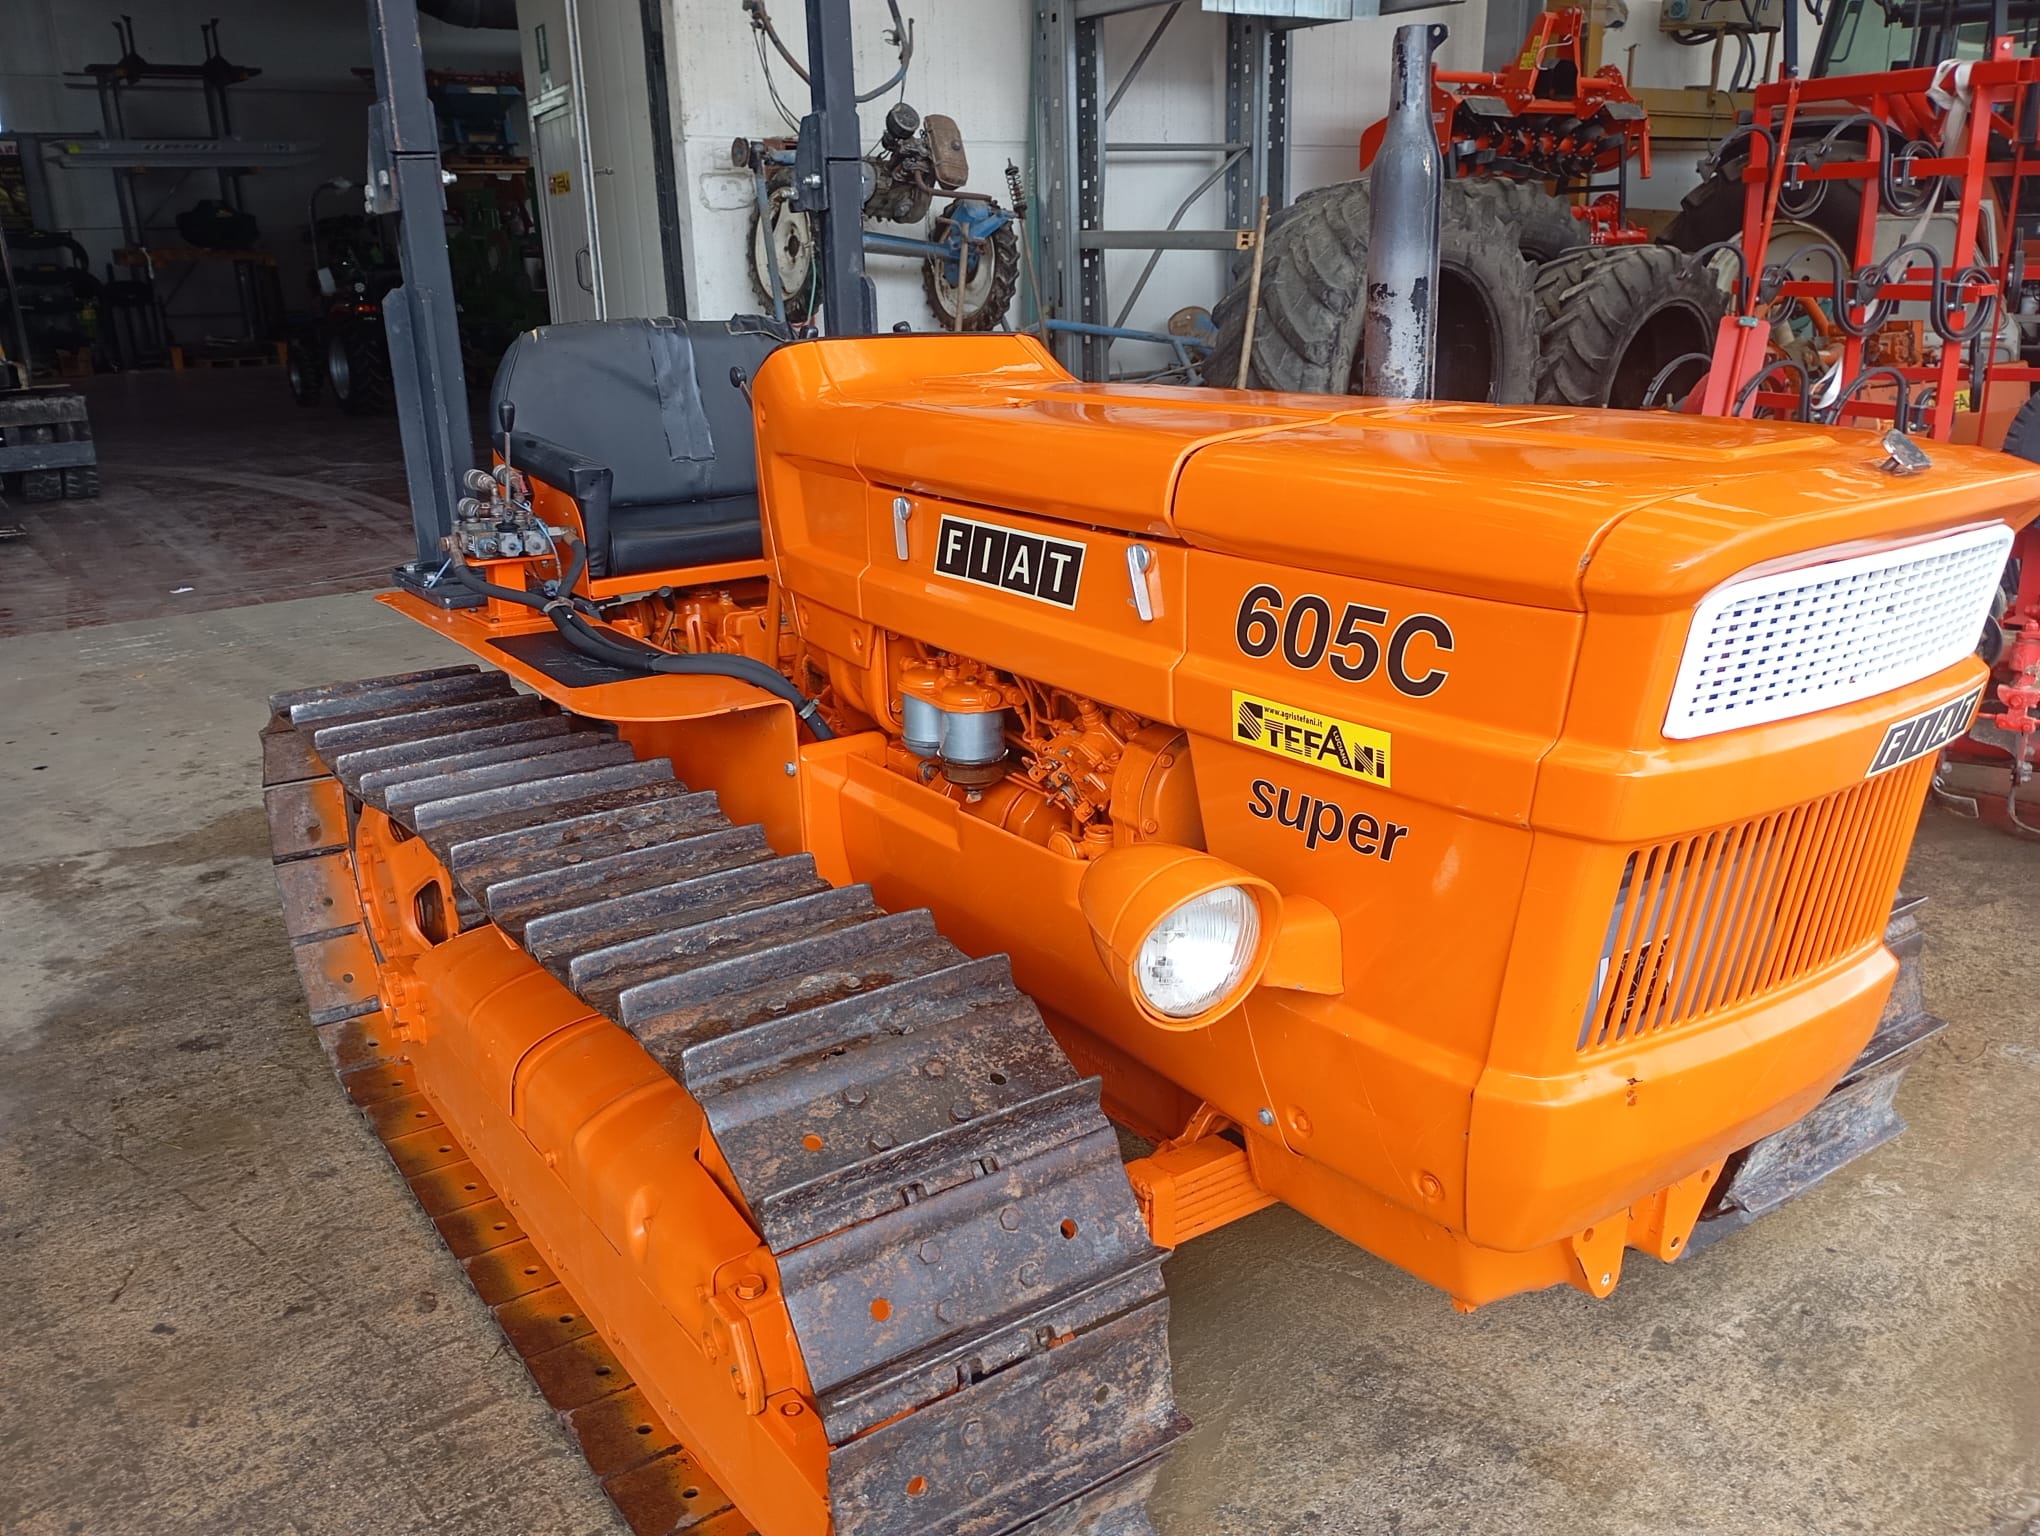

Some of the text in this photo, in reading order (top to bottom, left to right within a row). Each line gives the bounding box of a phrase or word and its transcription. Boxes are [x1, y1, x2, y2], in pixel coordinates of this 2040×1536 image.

[944, 528, 1073, 594] FIAT
[1235, 583, 1455, 699] 605C
[1237, 700, 1386, 780] STEFANI
[1263, 705, 1324, 729] www.agristefani.it
[1332, 729, 1350, 767] LUCIANO
[1879, 693, 1978, 766] FIAT
[1248, 778, 1410, 863] super
